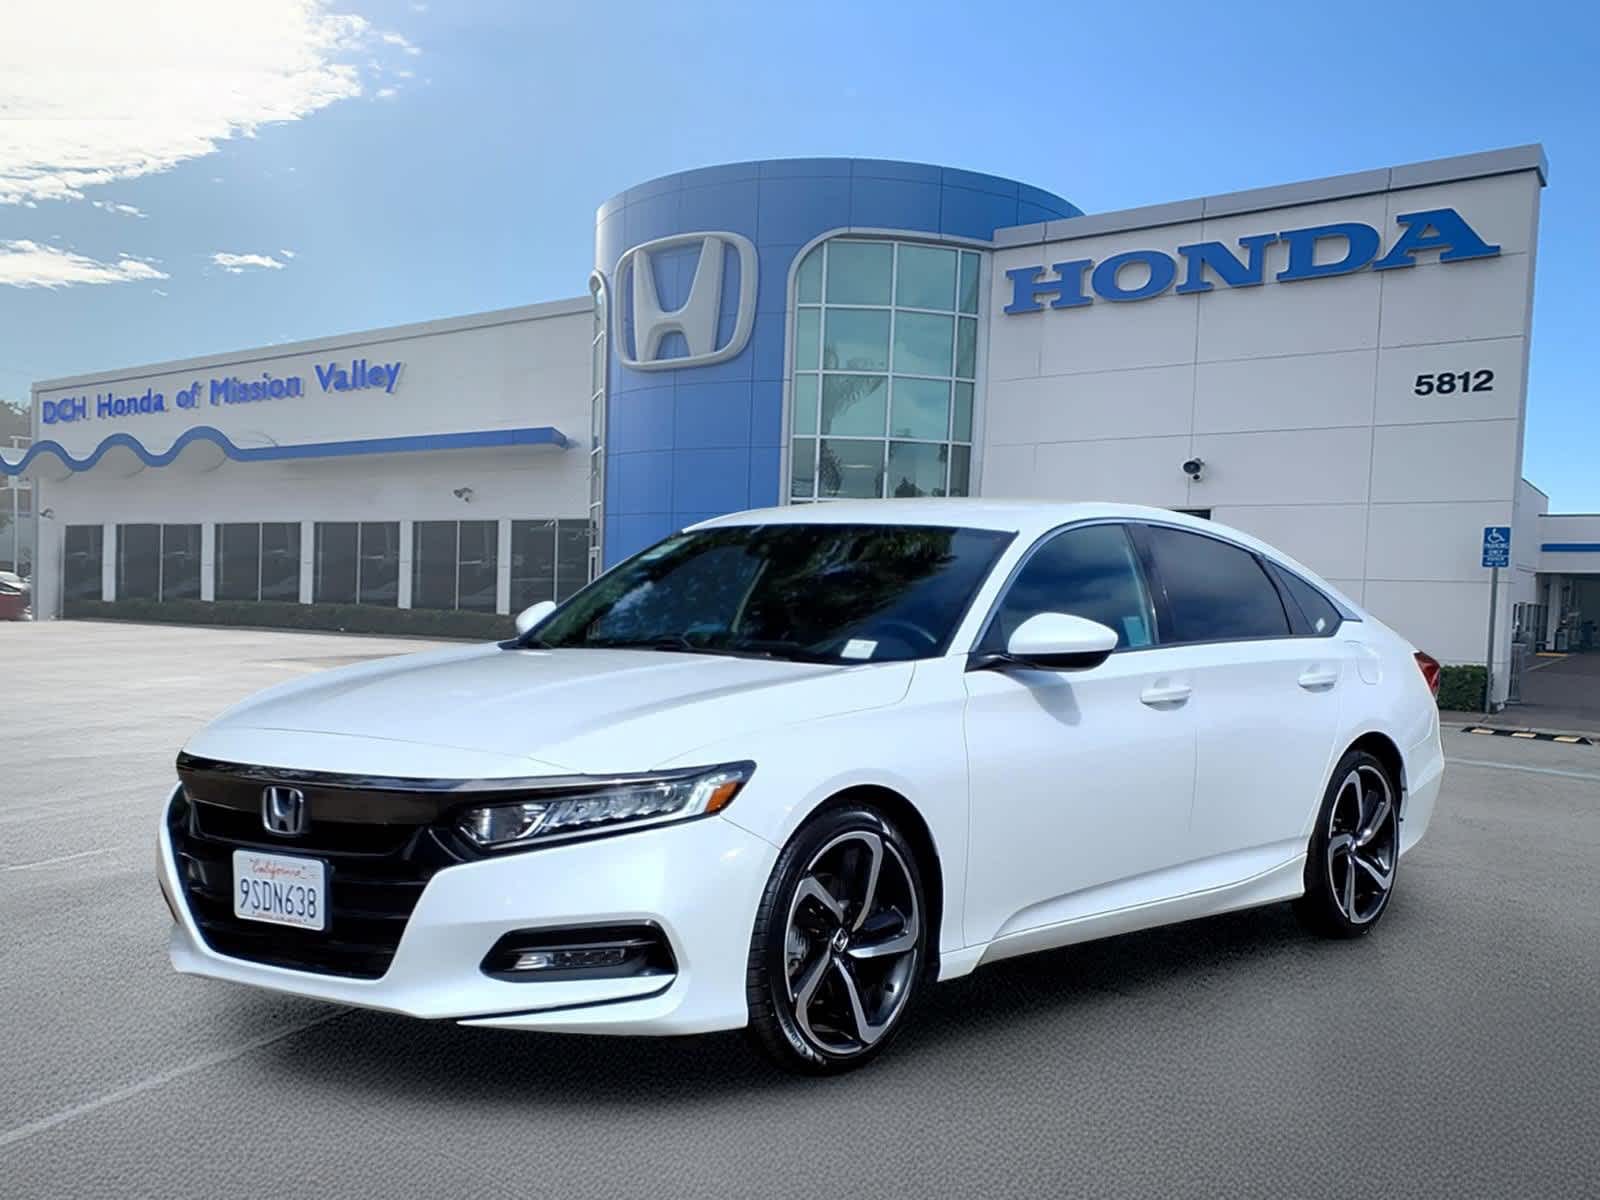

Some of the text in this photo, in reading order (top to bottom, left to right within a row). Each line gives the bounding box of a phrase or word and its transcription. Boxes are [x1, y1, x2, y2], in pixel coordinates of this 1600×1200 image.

[1003, 208, 1501, 316] HONDA
[42, 359, 402, 425] DCH Honda of Mission Valley
[1414, 369, 1494, 396] 5812
[240, 878, 317, 919] 9SDN638
